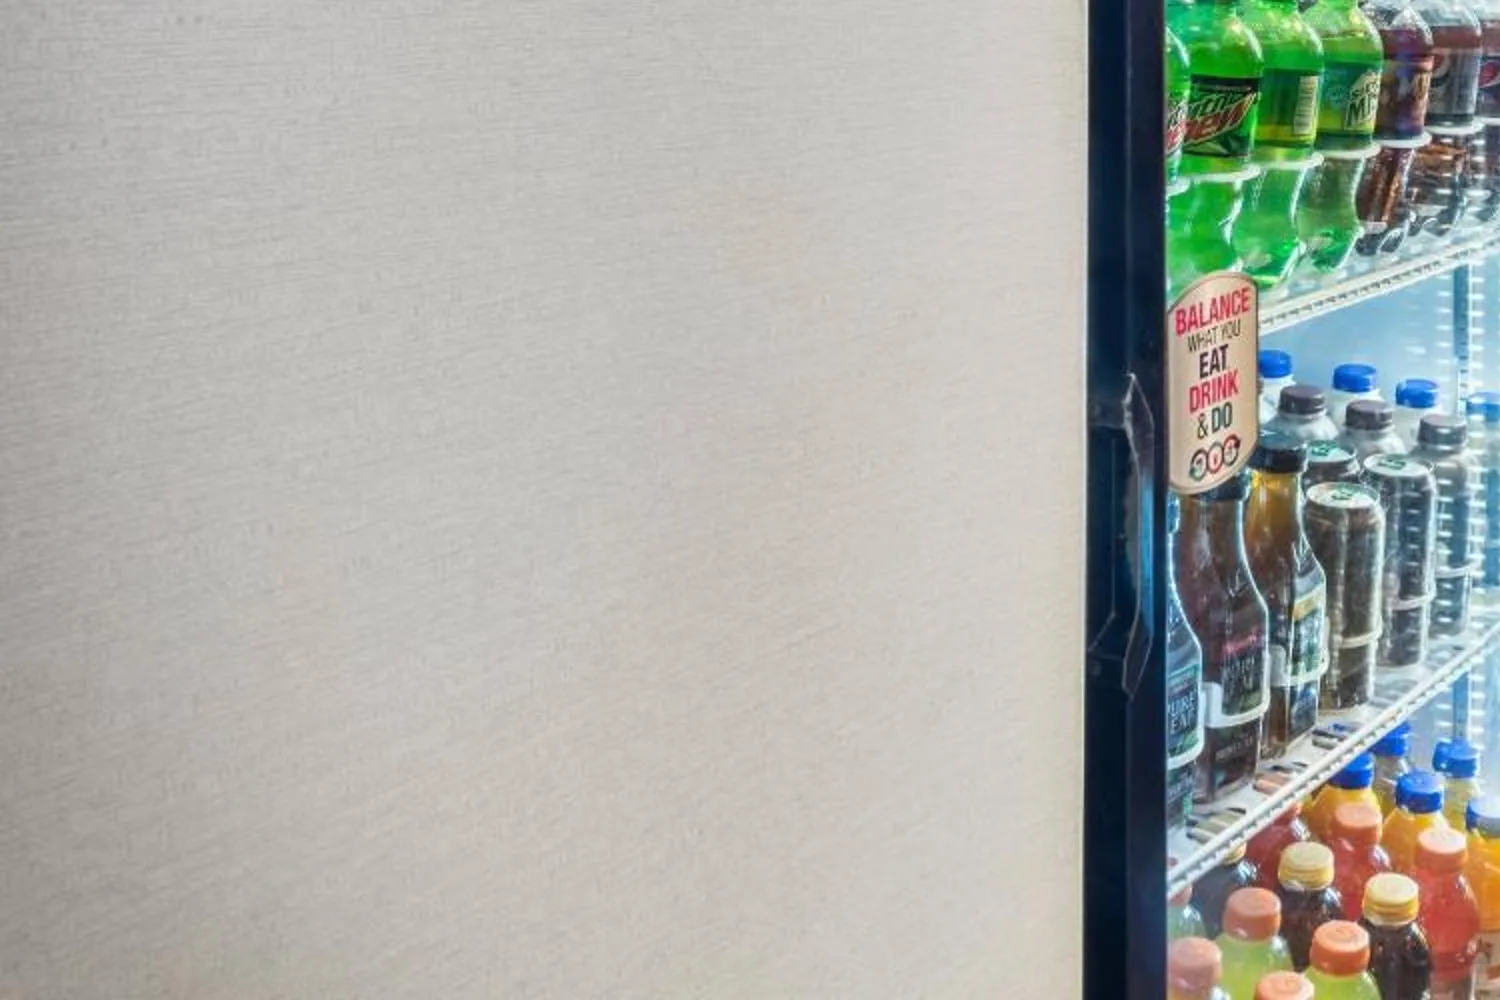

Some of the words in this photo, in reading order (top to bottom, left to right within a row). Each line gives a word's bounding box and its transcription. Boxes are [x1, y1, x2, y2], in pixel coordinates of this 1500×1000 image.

[1174, 287, 1249, 336] BALANCE
[1187, 326, 1217, 351] WHAT
[1221, 319, 1241, 341] YOU
[1199, 344, 1229, 378] EAT
[1188, 371, 1239, 414] DRINK
[1197, 414, 1209, 439] &
[1211, 402, 1233, 433] DO
